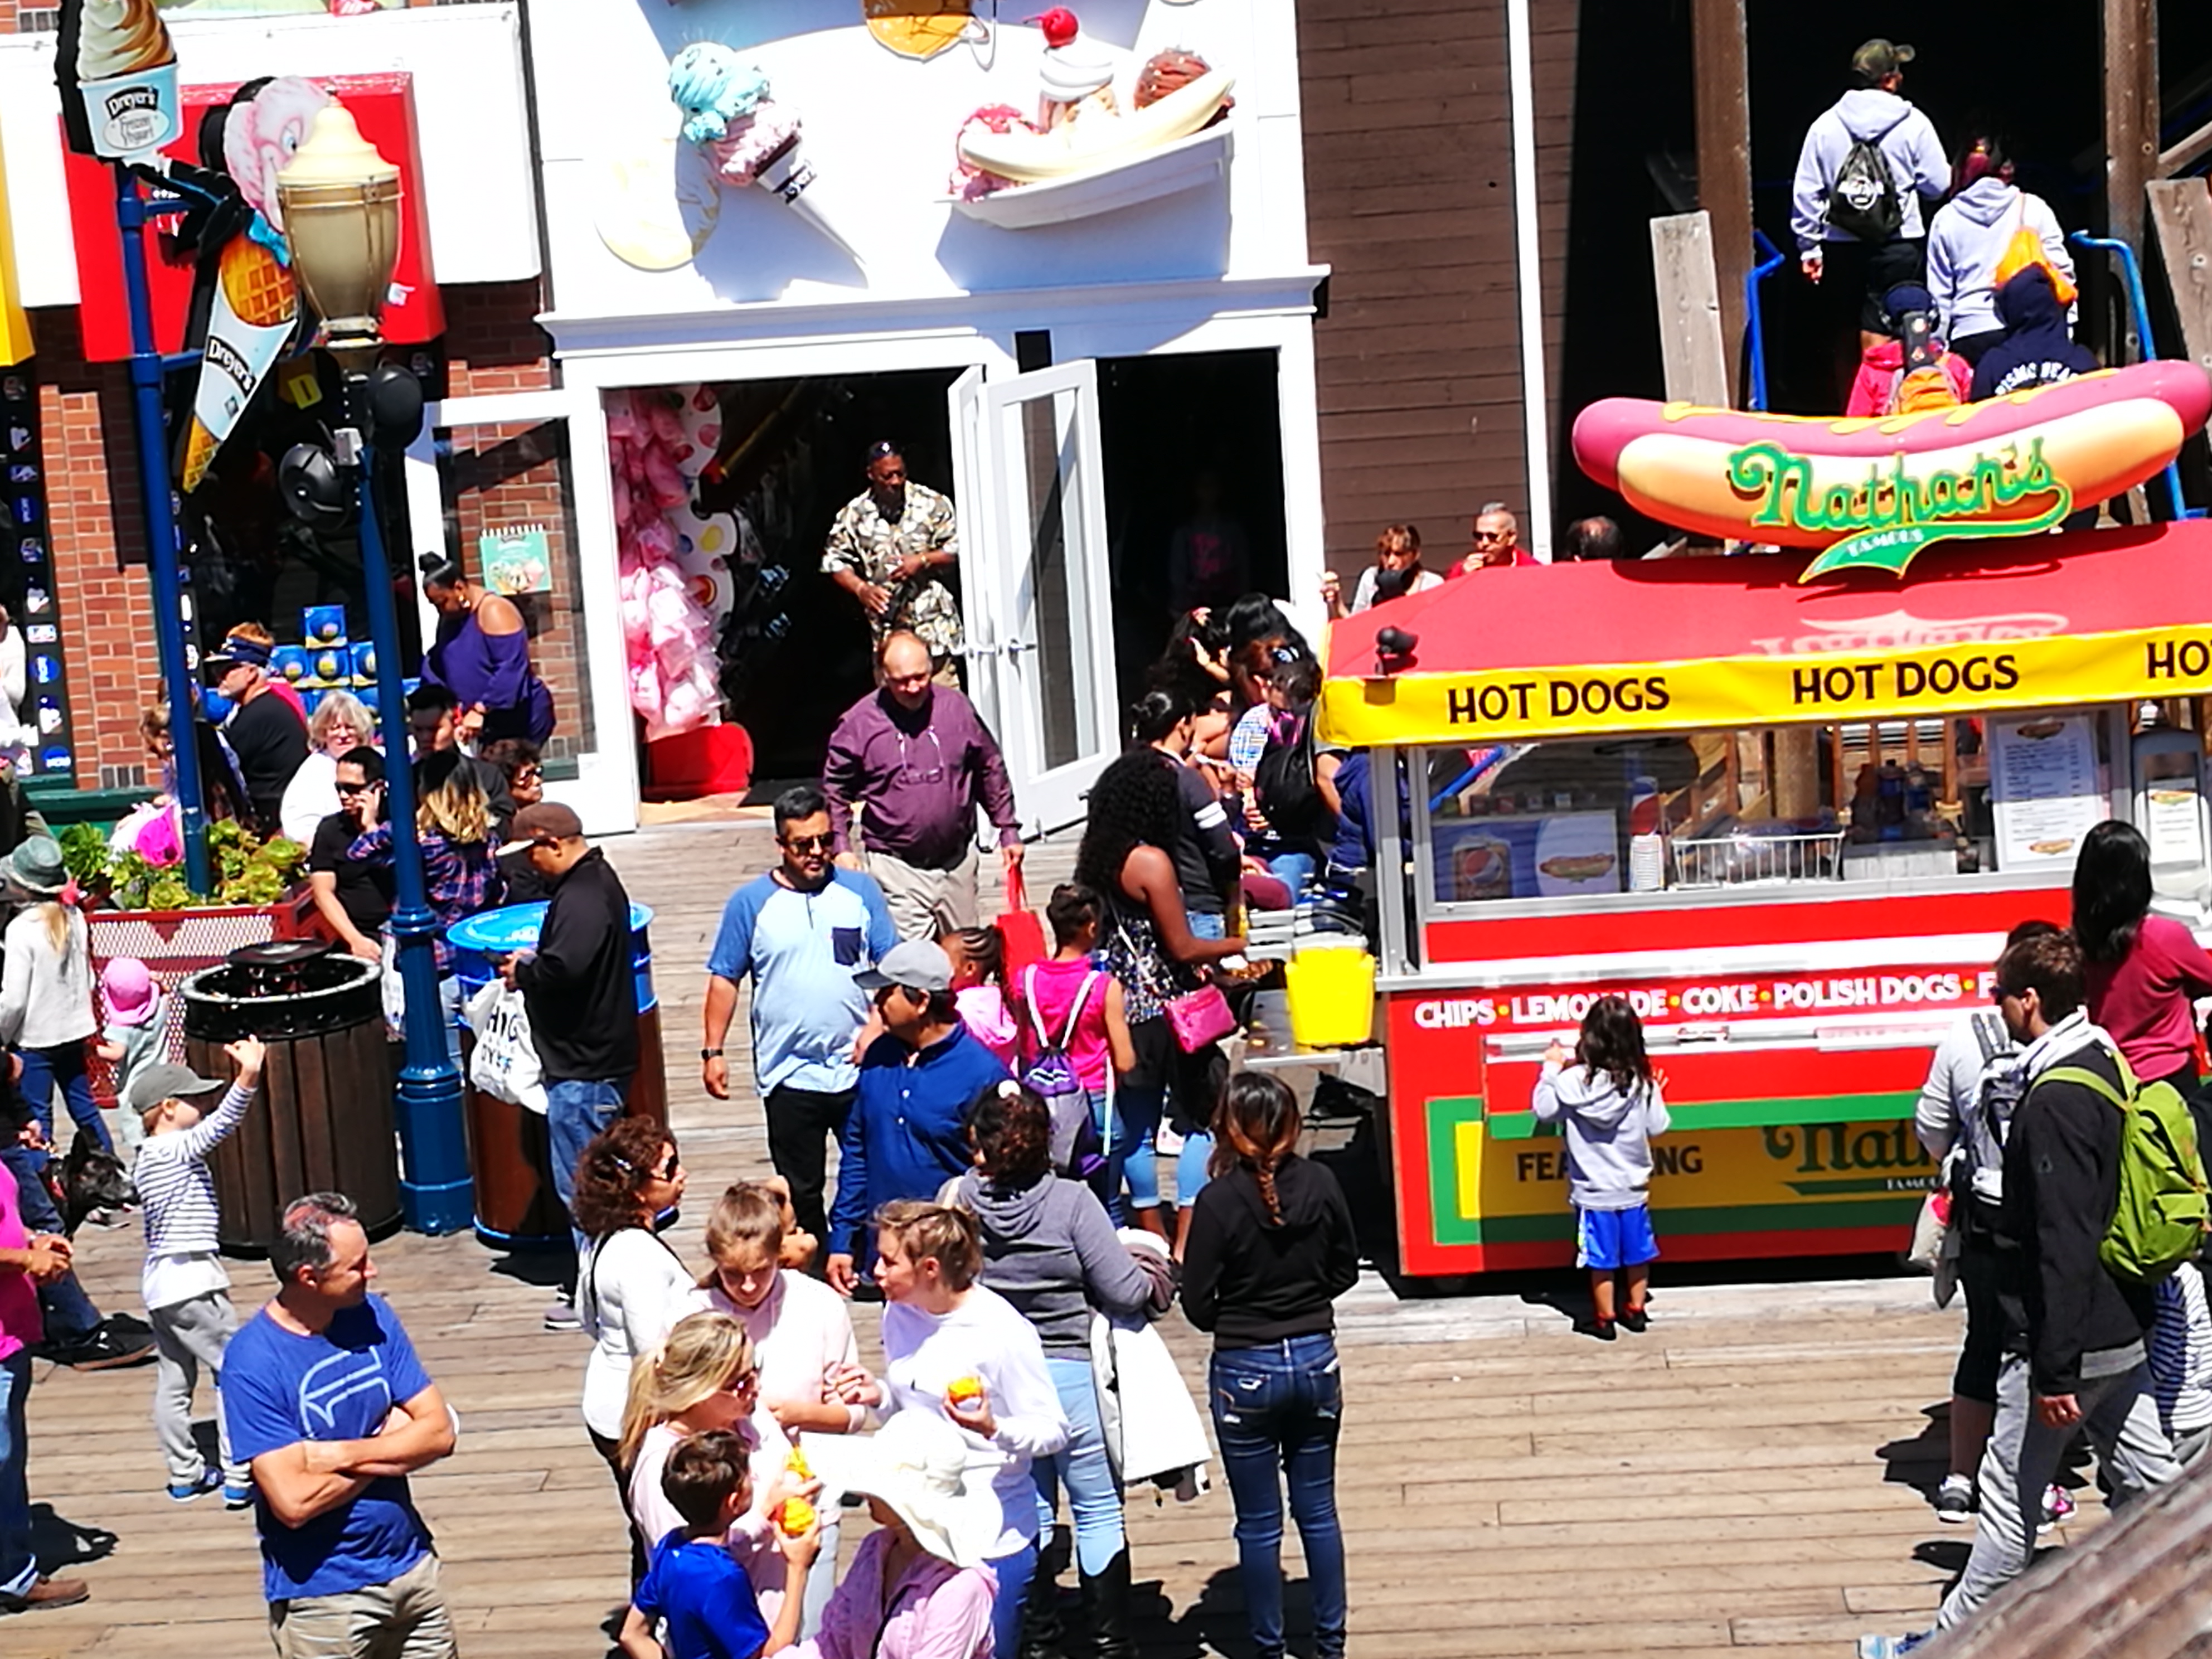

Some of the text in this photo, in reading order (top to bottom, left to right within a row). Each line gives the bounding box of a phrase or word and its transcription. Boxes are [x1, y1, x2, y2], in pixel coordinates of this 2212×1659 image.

[1728, 436, 2063, 533] Nathan's
[1846, 528, 1924, 558] FAMOUS
[1793, 654, 2019, 704] HOT DOGS
[2147, 639, 2212, 679] HO
[1448, 676, 1670, 724] HOT DOGS
[1415, 998, 1496, 1028] CHIPS
[1511, 988, 1668, 1023] LEMODE
[1682, 978, 1759, 1014] COKE
[1774, 977, 1877, 1010] POLISH
[1881, 973, 1961, 1005] DOGS
